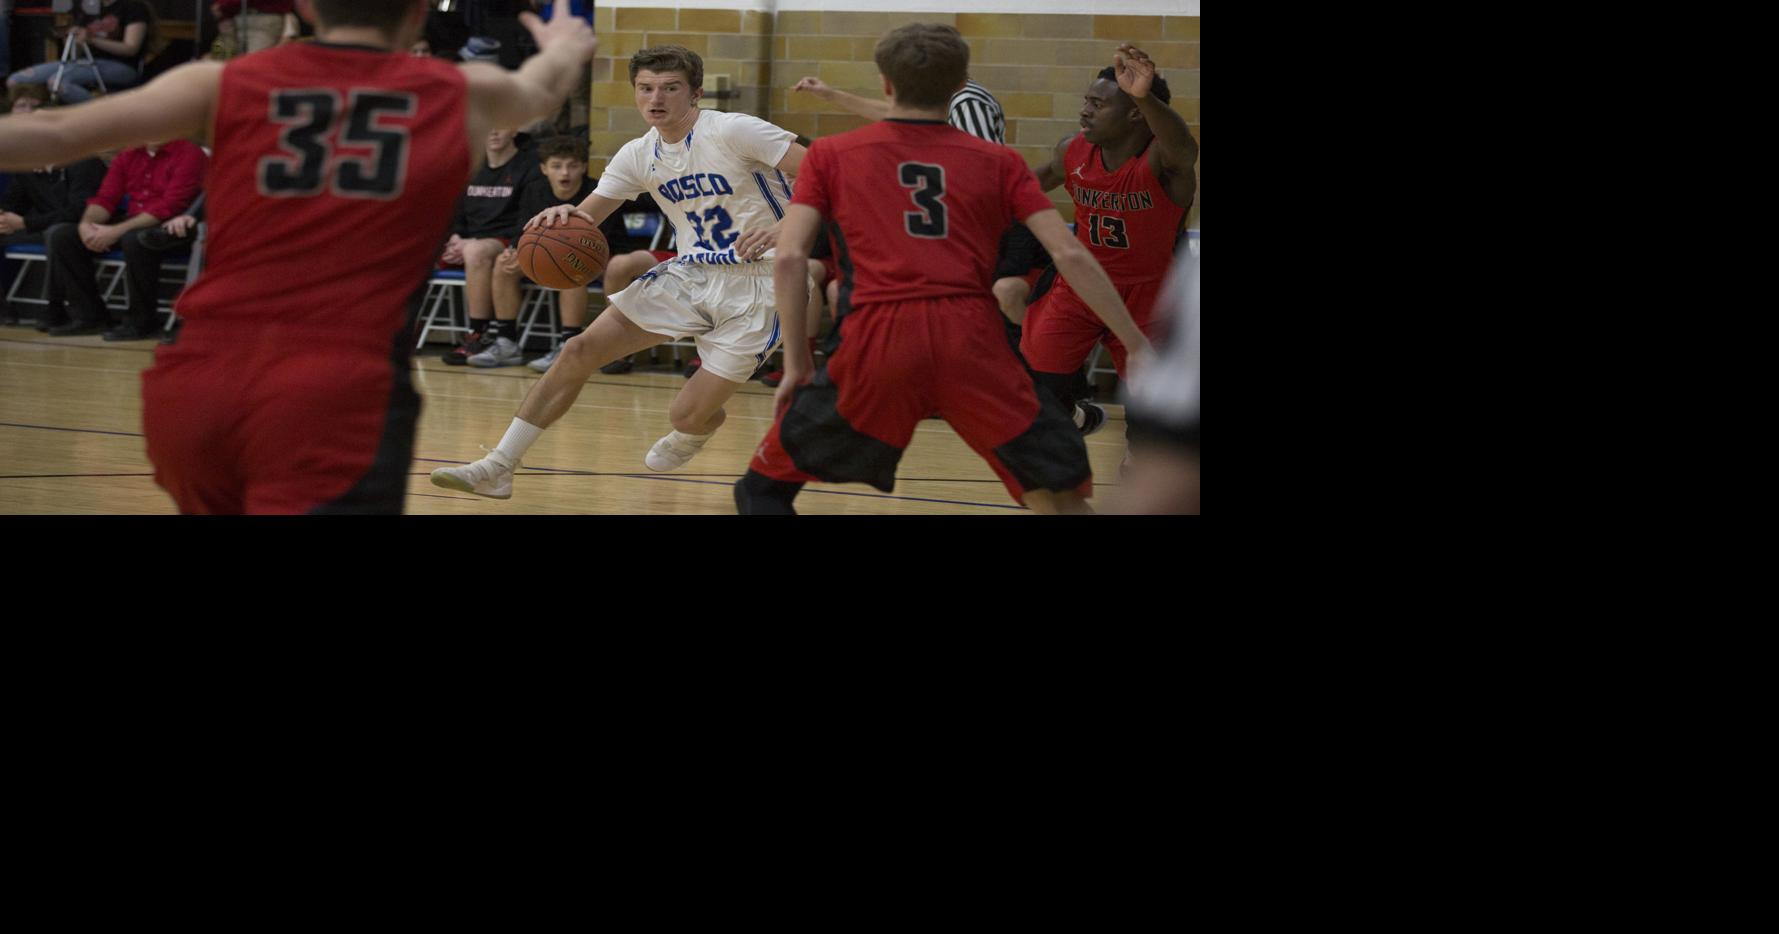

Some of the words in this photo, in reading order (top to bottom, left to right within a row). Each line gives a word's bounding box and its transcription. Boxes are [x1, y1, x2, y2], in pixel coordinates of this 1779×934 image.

[256, 88, 418, 200] 35
[657, 173, 734, 204] BOSCO
[897, 161, 948, 239] 3
[1072, 182, 1154, 212] UNKERTON
[1089, 212, 1130, 250] 13
